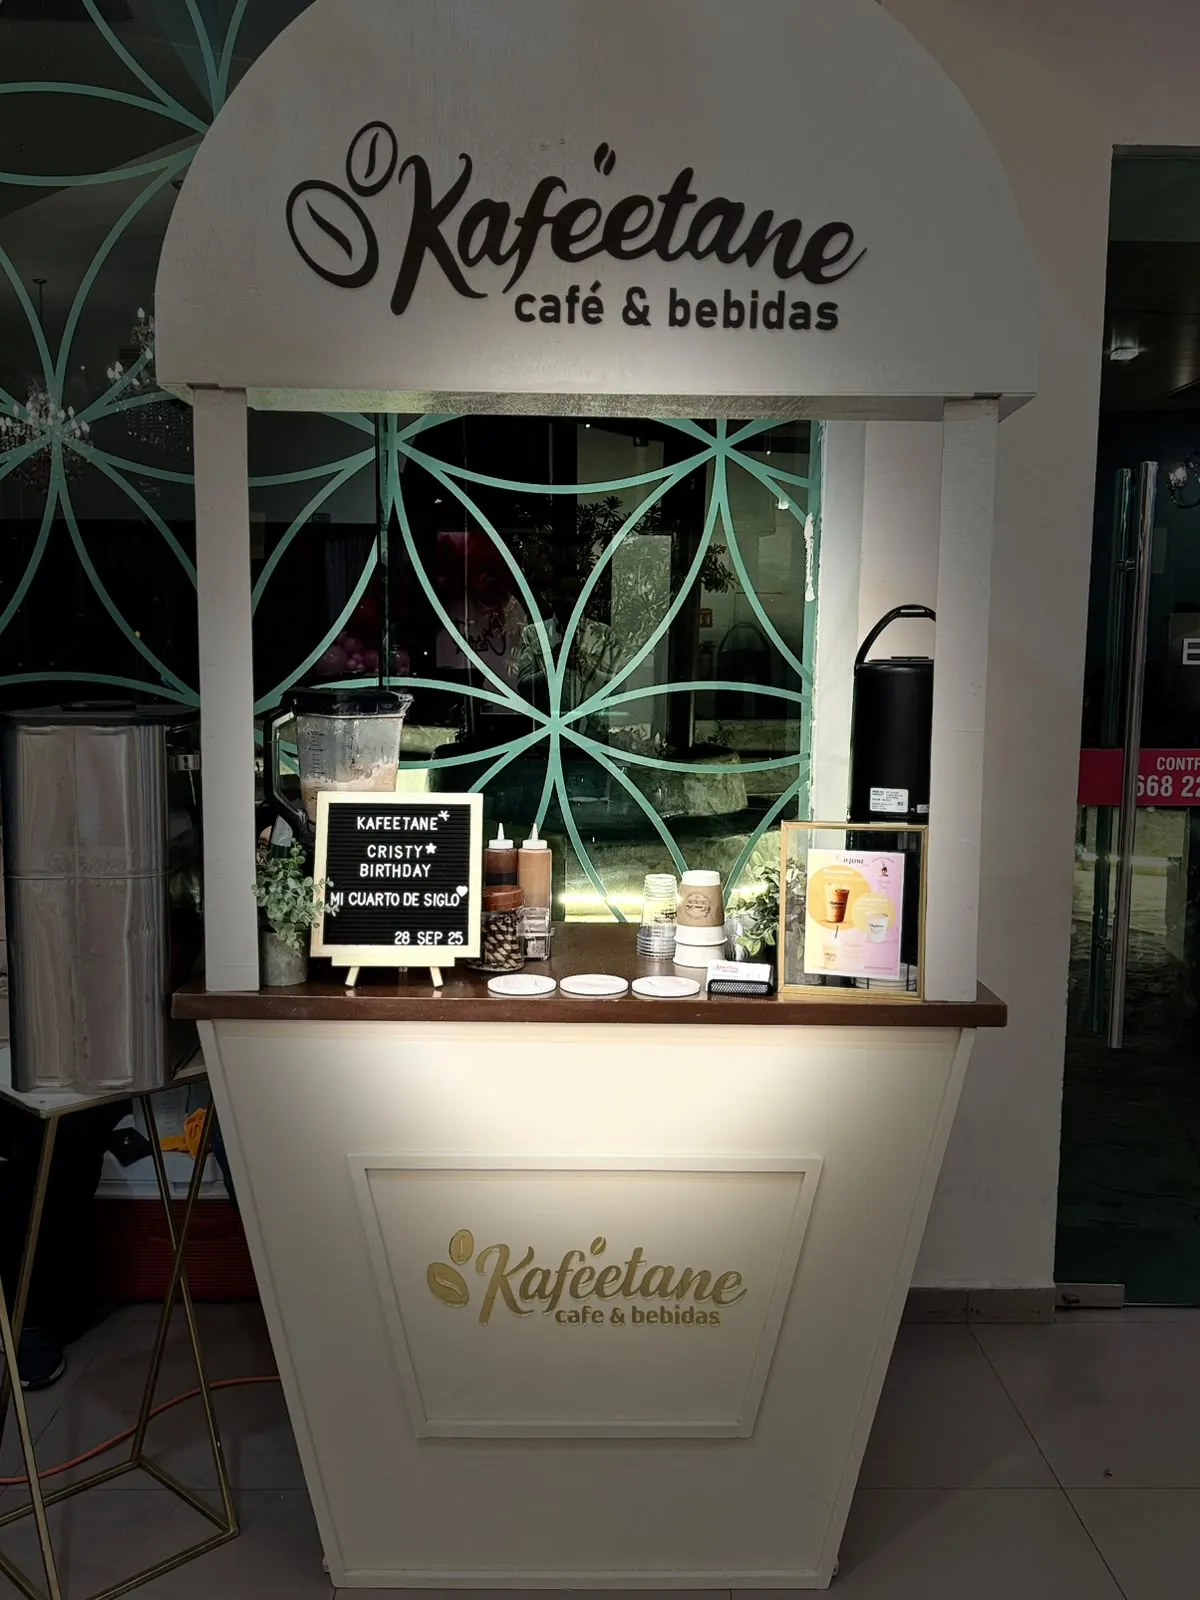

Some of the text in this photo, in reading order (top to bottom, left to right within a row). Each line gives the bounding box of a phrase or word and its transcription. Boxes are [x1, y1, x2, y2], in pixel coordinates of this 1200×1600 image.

[514, 280, 840, 330] café & bebidas
[357, 815, 439, 831] KAFEETANE
[367, 844, 423, 859] CRISTY
[360, 863, 431, 878] BIRTHDAY
[330, 892, 460, 907] MI CUARTO DE SIGLO
[394, 931, 464, 946] 28 SEP 25
[555, 1304, 721, 1326] cafe & bebidas
